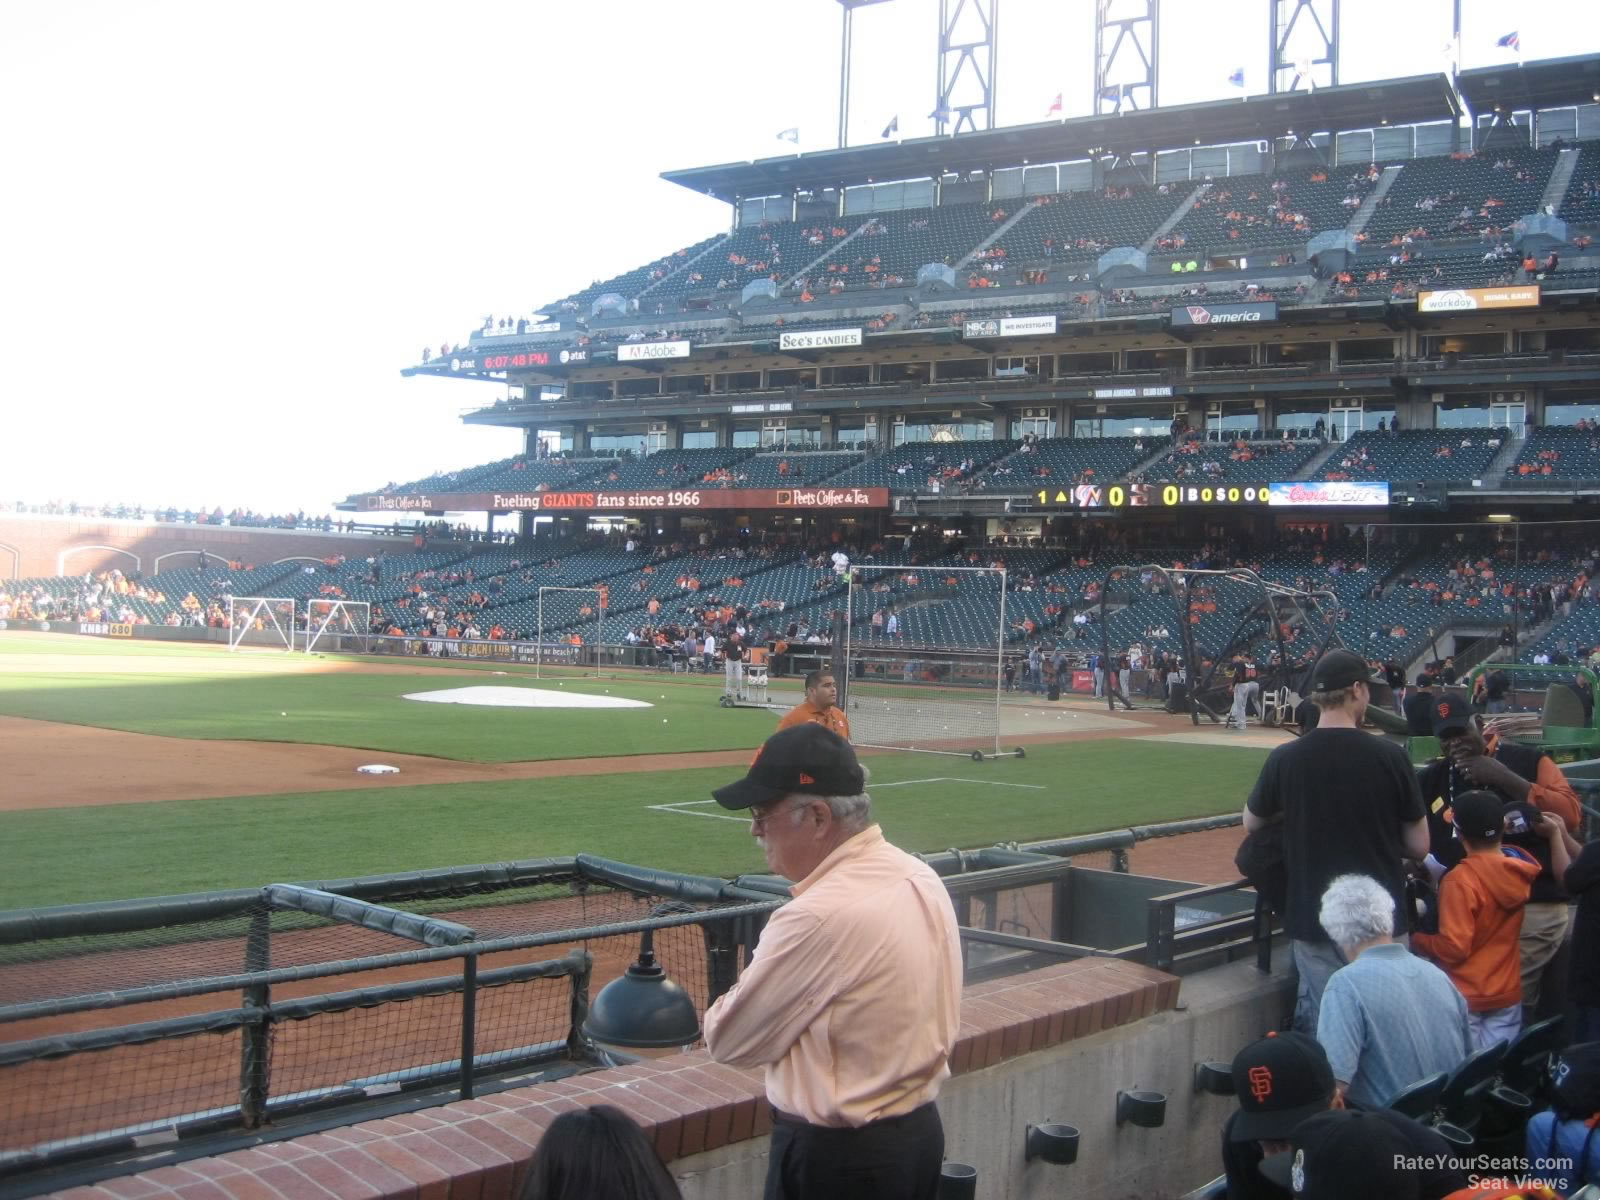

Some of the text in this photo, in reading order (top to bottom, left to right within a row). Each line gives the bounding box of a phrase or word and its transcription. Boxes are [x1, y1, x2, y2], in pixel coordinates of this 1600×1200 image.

[1429, 299, 1472, 309] workday
[1210, 311, 1261, 324] america
[966, 321, 986, 331] NBC
[1015, 321, 1053, 330] INVESTIGATE
[782, 332, 857, 348] See's CANDIES
[642, 344, 676, 358] Adobe
[529, 352, 548, 365] PM
[494, 491, 700, 510] Fueling GIANTS fans since 1966
[817, 490, 844, 507] Coffee
[844, 493, 853, 503] &
[852, 489, 869, 505] Tea
[1037, 490, 1046, 504] 1
[1108, 486, 1124, 507] 0
[1162, 485, 1178, 506] 0
[1188, 488, 1199, 502] B
[1216, 487, 1226, 502] S
[80, 623, 130, 635] KNBR 680
[1248, 1066, 1273, 1104] SF
